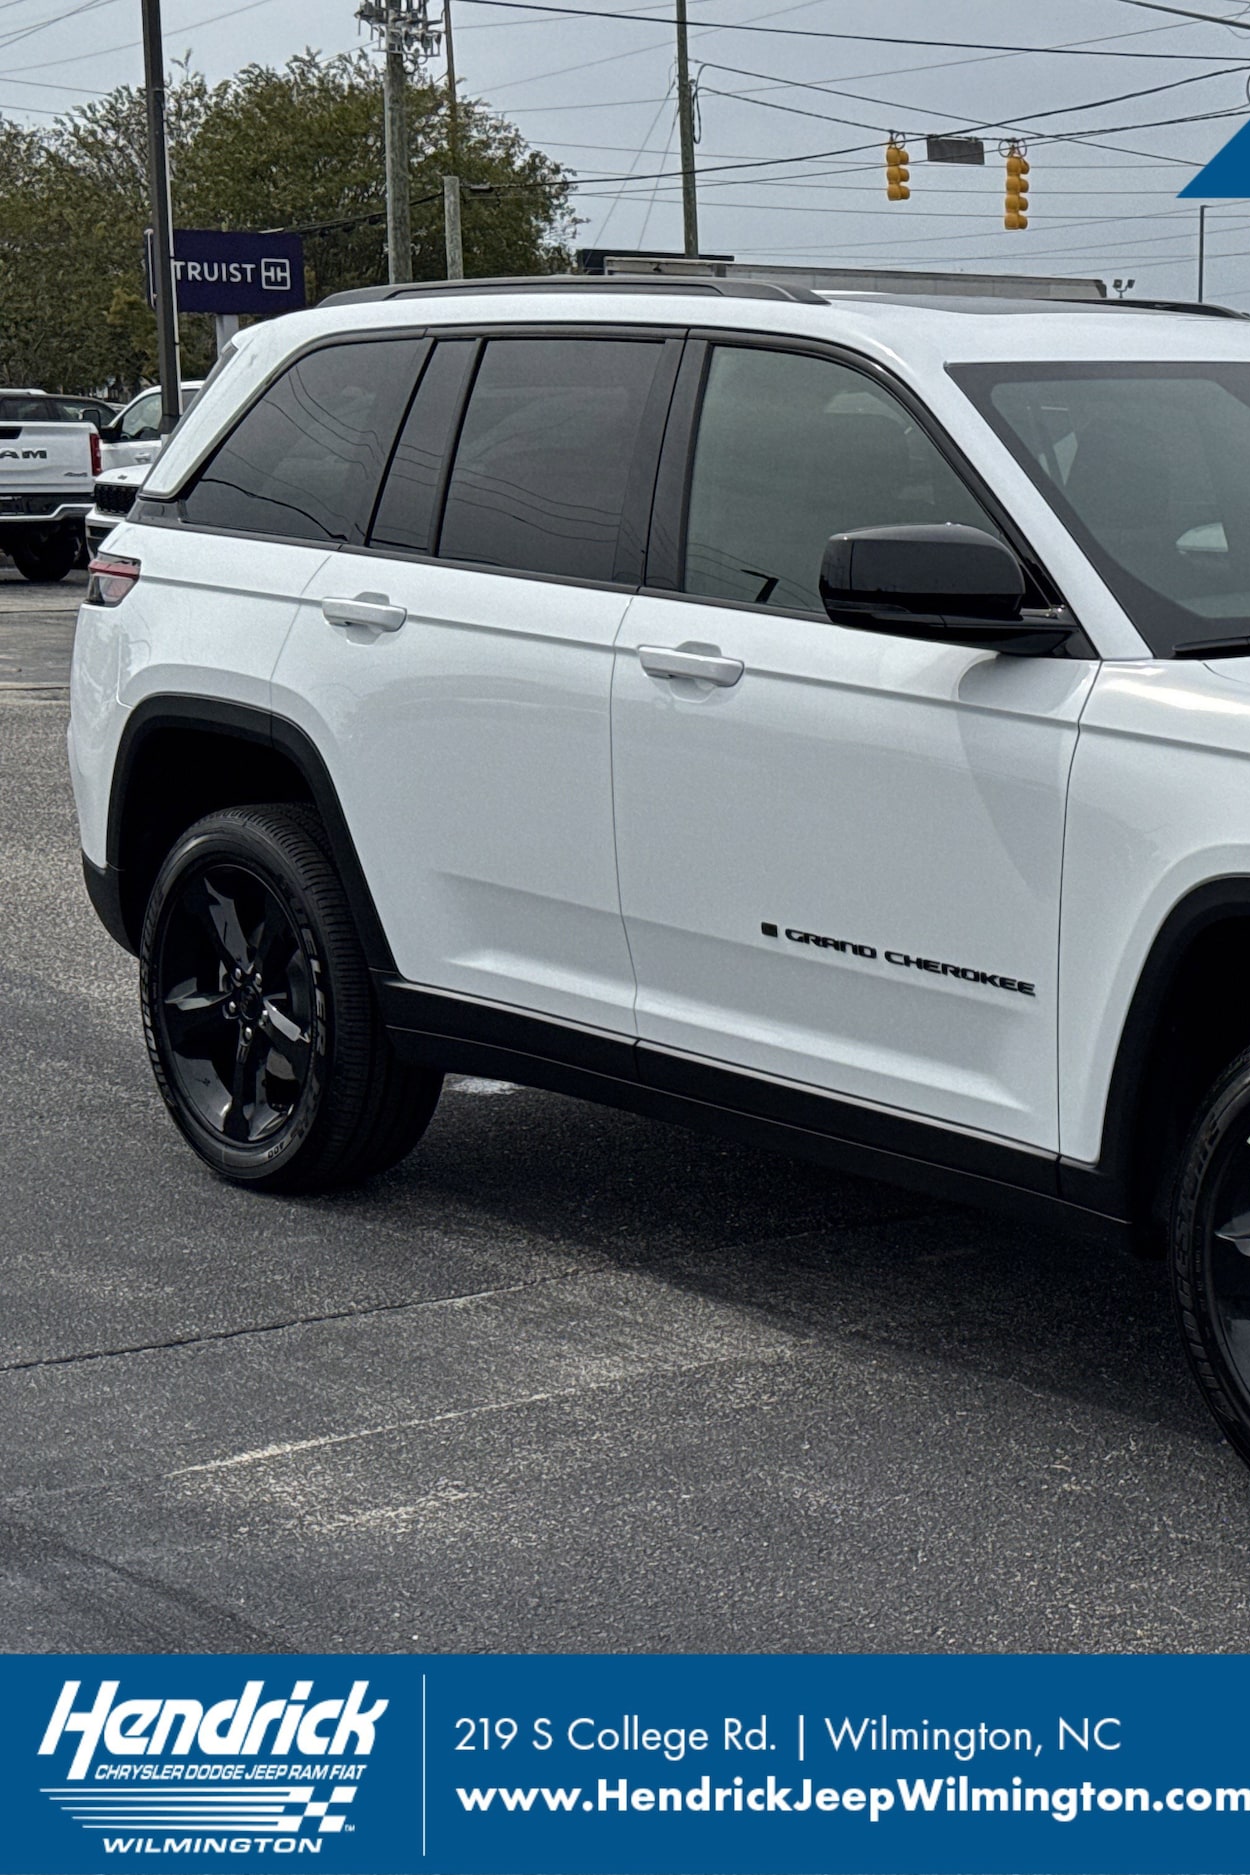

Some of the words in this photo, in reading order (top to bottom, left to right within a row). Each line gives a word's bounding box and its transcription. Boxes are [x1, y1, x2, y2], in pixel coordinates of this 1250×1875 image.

[174, 260, 256, 283] TRUIST
[0, 450, 48, 460] AM
[784, 928, 878, 960] GRAND
[884, 950, 1037, 997] CHEROKEE
